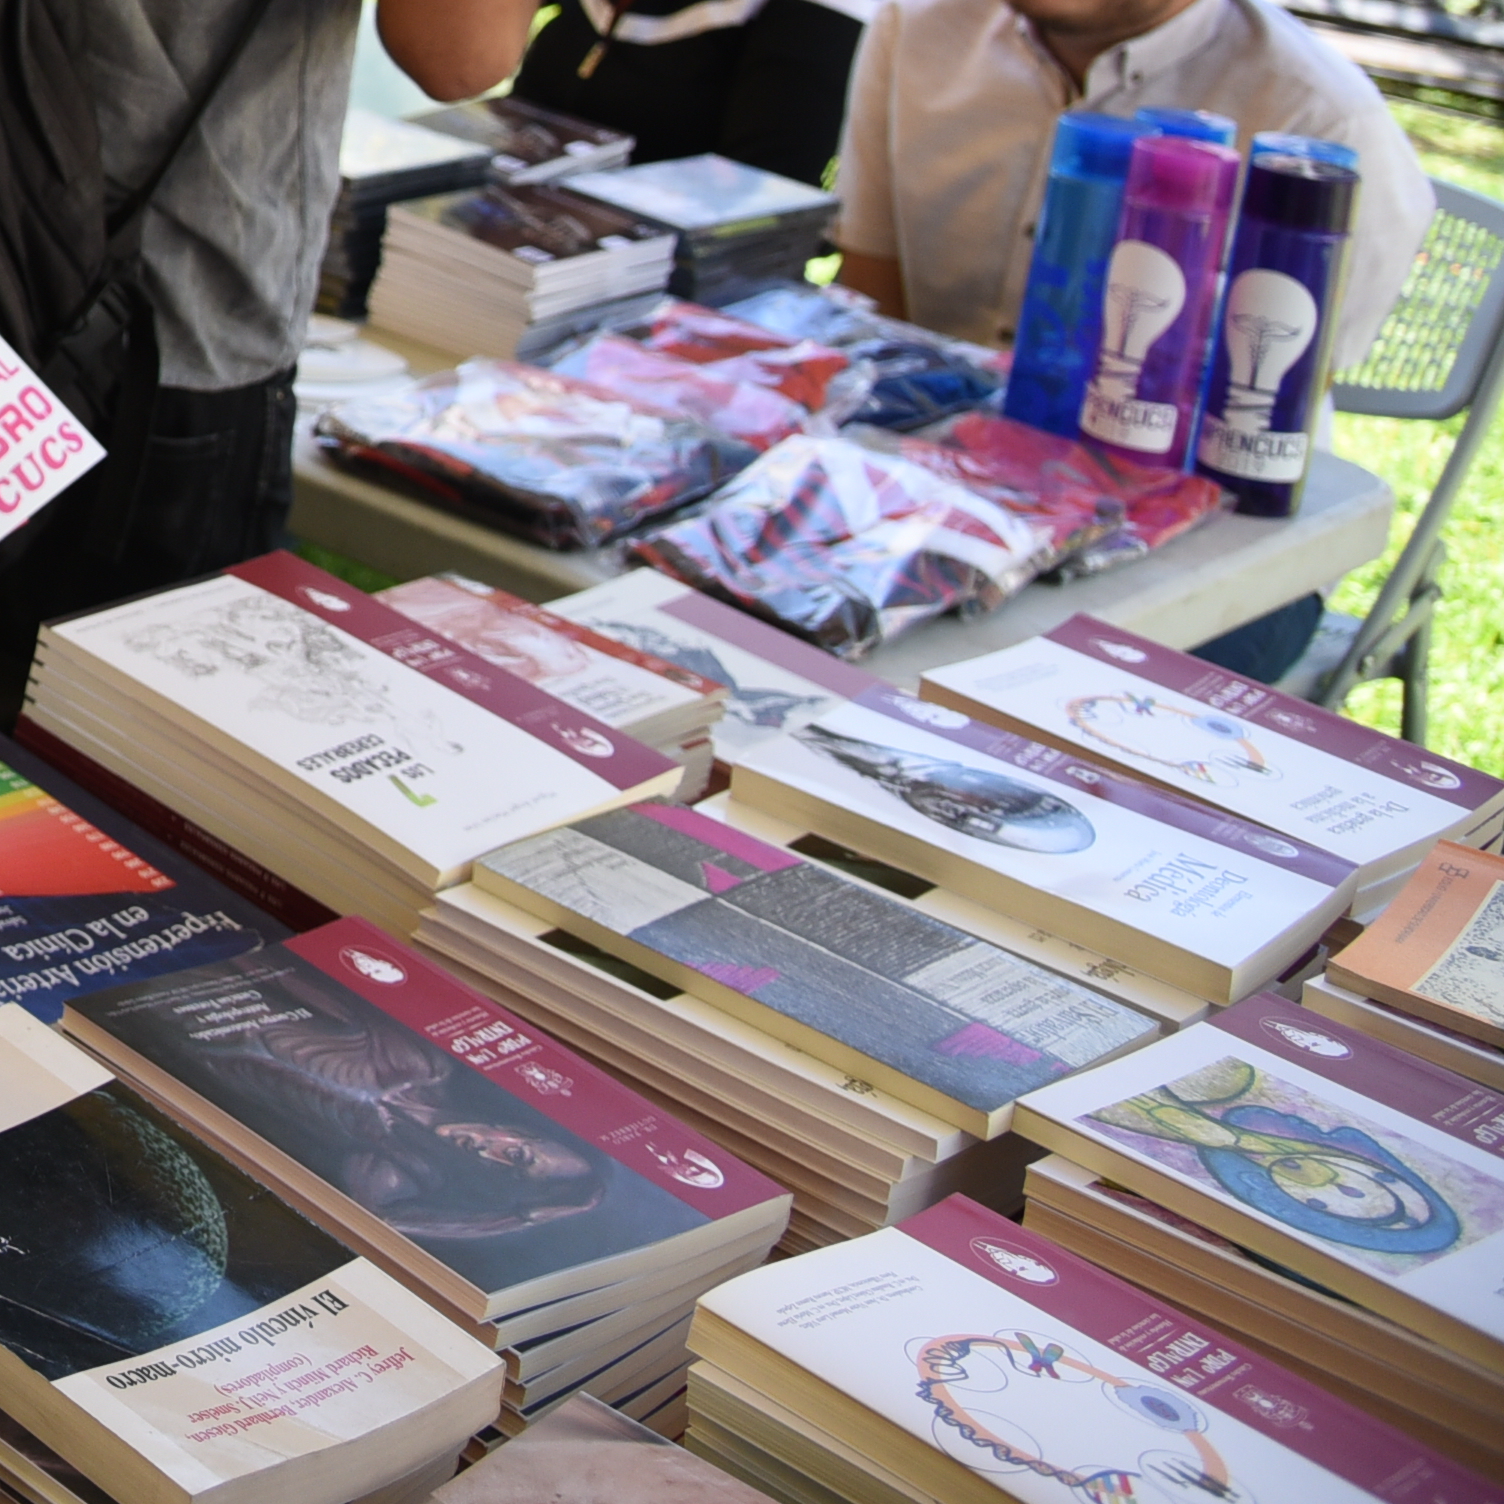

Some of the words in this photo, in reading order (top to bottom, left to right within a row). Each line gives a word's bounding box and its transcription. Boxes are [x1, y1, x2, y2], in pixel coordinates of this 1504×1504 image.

[296, 733, 385, 772] CEREBRALES
[329, 747, 413, 783] PECADOS
[1123, 852, 1218, 903] Médica
[86, 918, 127, 939] la
[113, 904, 150, 929] en
[0, 925, 95, 962] Clínica
[311, 1288, 350, 1320] El
[236, 1301, 319, 1349] vínculo
[105, 1335, 242, 1392] micro-macro
[325, 1344, 380, 1378] Richard
[366, 1346, 416, 1380] Jeffrey
[1145, 1331, 1212, 1373] ENTRALGO
[1198, 1348, 1238, 1375] PEDRO
[213, 1352, 313, 1399] (compiladores)
[273, 1384, 287, 1398] y
[285, 1368, 326, 1395] Münch
[354, 1370, 372, 1389] C.
[234, 1393, 253, 1411] J.
[249, 1388, 278, 1410] Neil
[290, 1378, 358, 1412] Alexander,
[186, 1401, 235, 1426] Smelser
[235, 1403, 296, 1432] Bernhard
[186, 1421, 238, 1445] Giesen,
